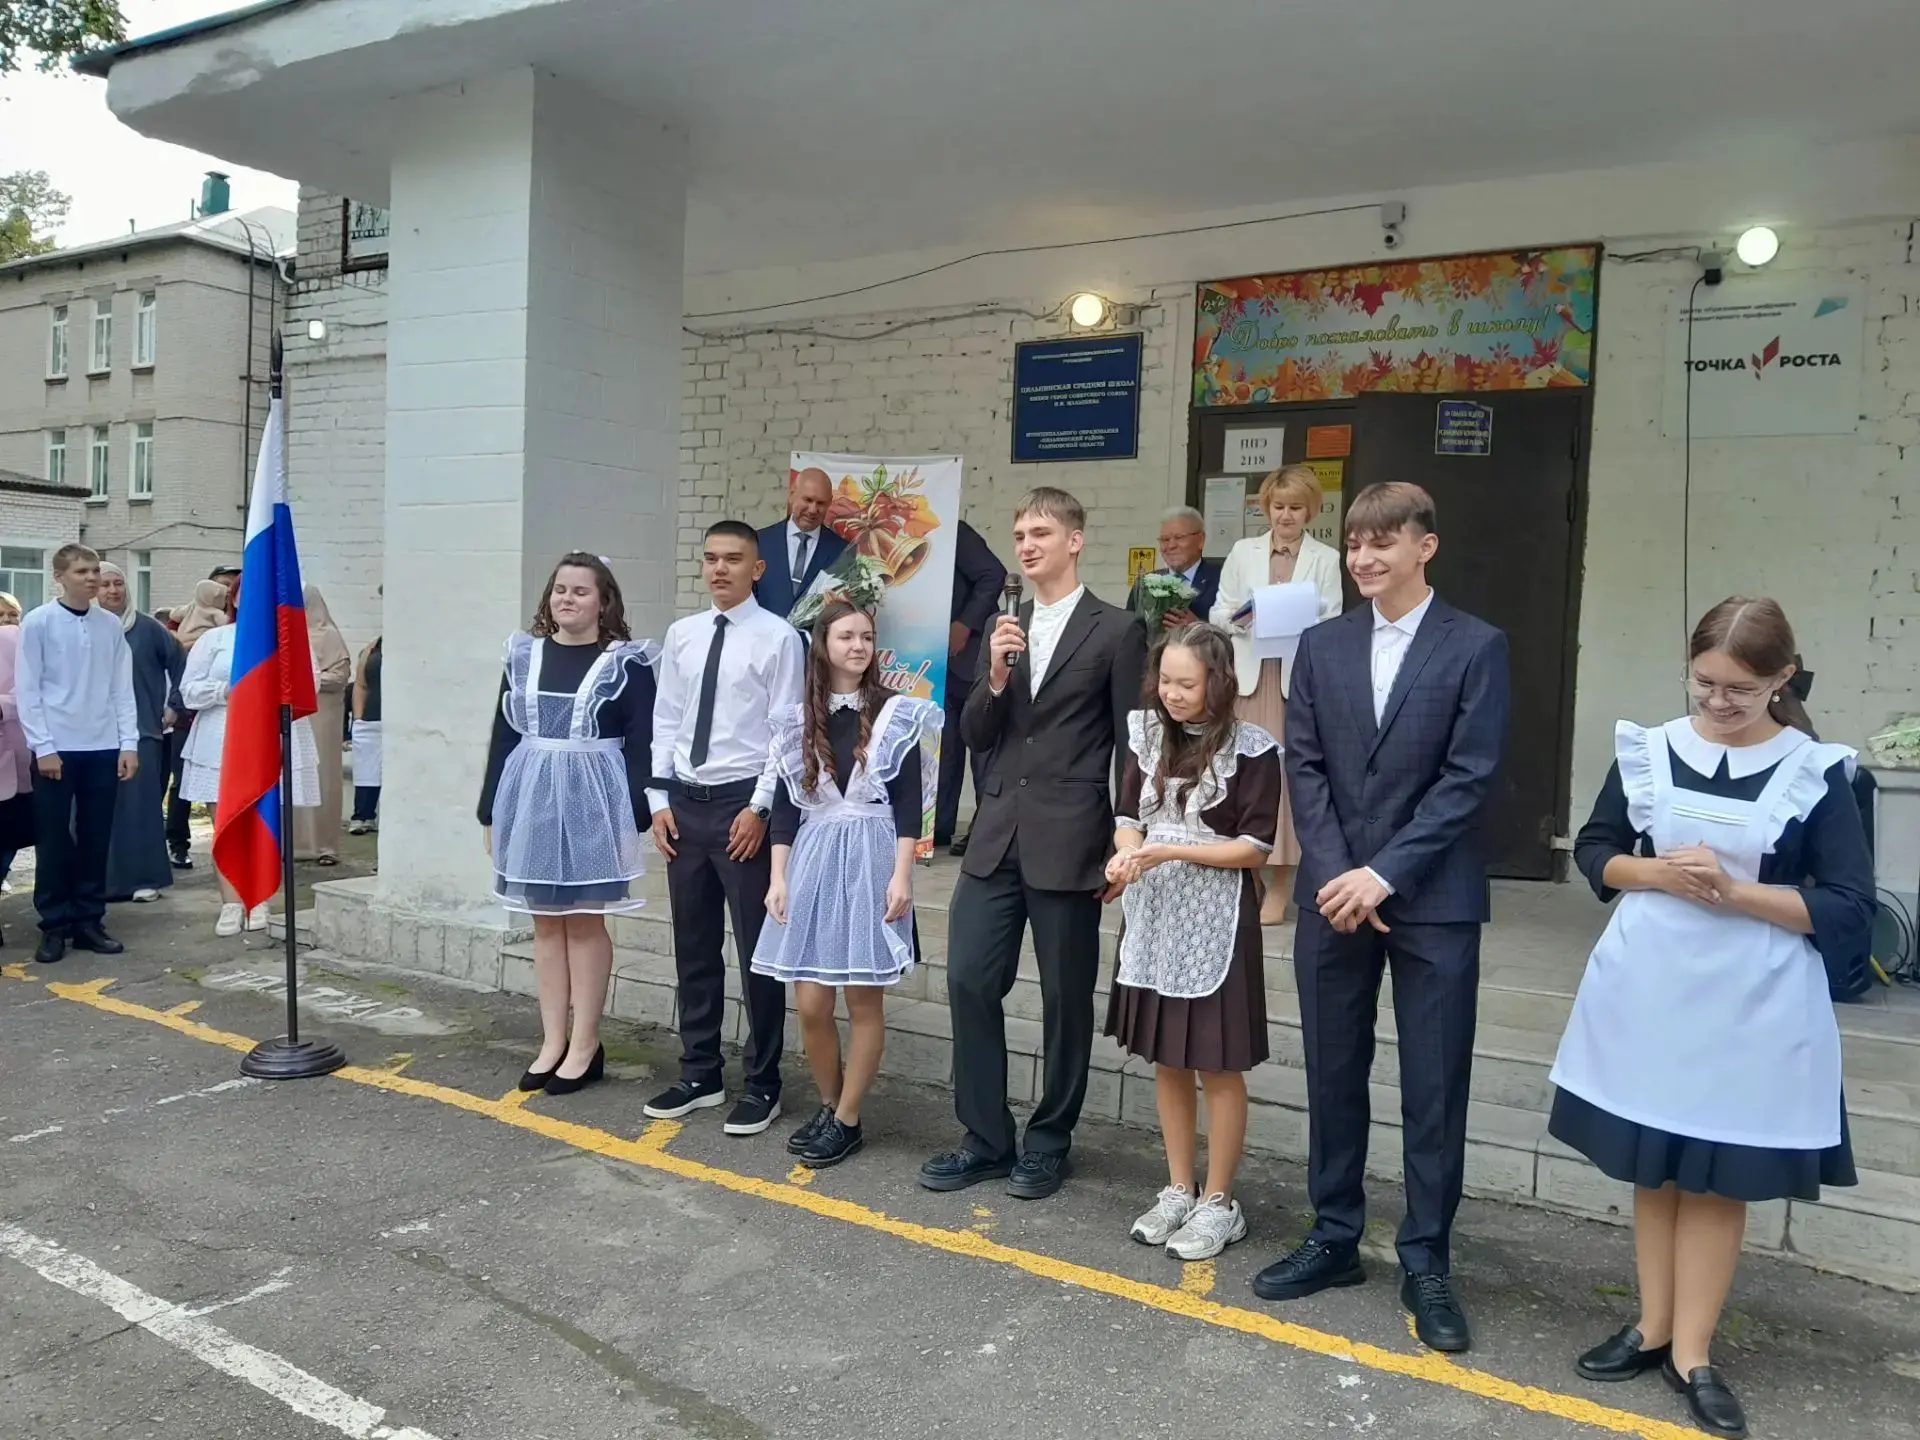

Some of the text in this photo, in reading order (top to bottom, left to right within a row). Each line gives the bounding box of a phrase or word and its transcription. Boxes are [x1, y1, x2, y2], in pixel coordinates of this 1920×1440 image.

[1230, 305, 1550, 354] Добро пожаловать в школу!
[1684, 353, 1842, 372] ТОЧКА РОСТА
[1240, 455, 1266, 466] 2118
